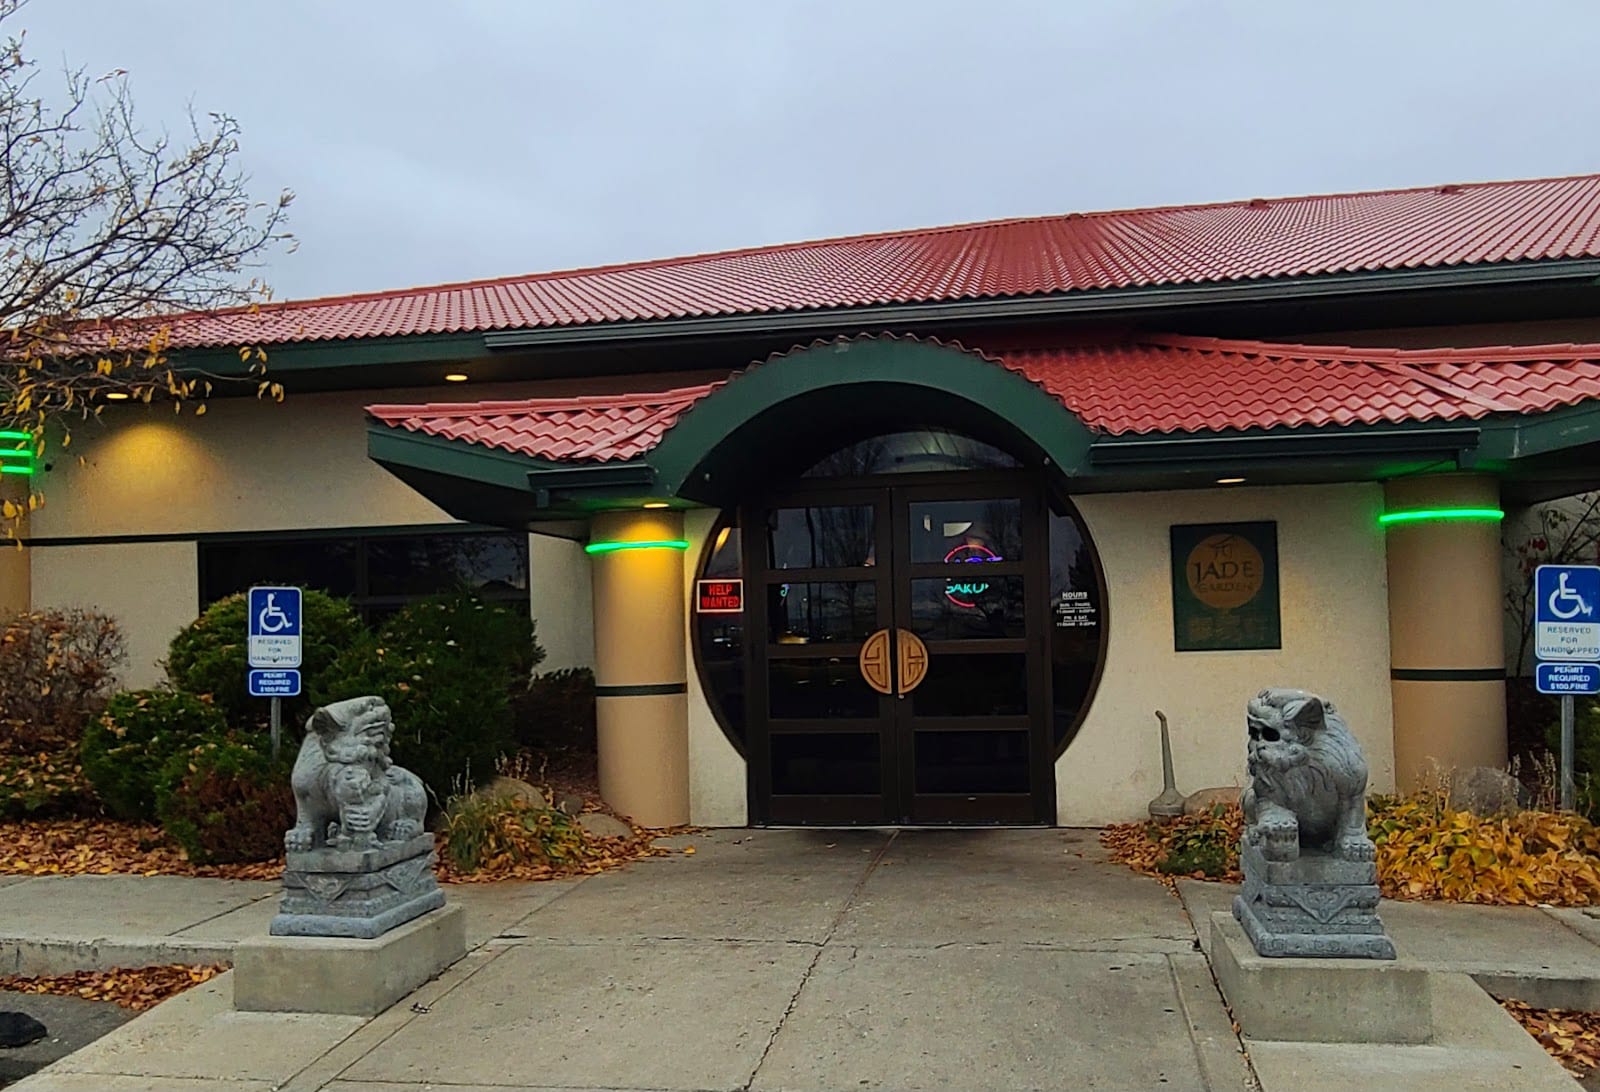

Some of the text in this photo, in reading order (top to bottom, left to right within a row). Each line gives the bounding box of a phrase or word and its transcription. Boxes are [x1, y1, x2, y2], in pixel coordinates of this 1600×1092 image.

[1193, 560, 1255, 584] JADE
[709, 584, 732, 595] HELP
[702, 596, 739, 608] WANTED
[1547, 625, 1591, 634] RESERVED
[1548, 674, 1590, 682] REQUIRED
